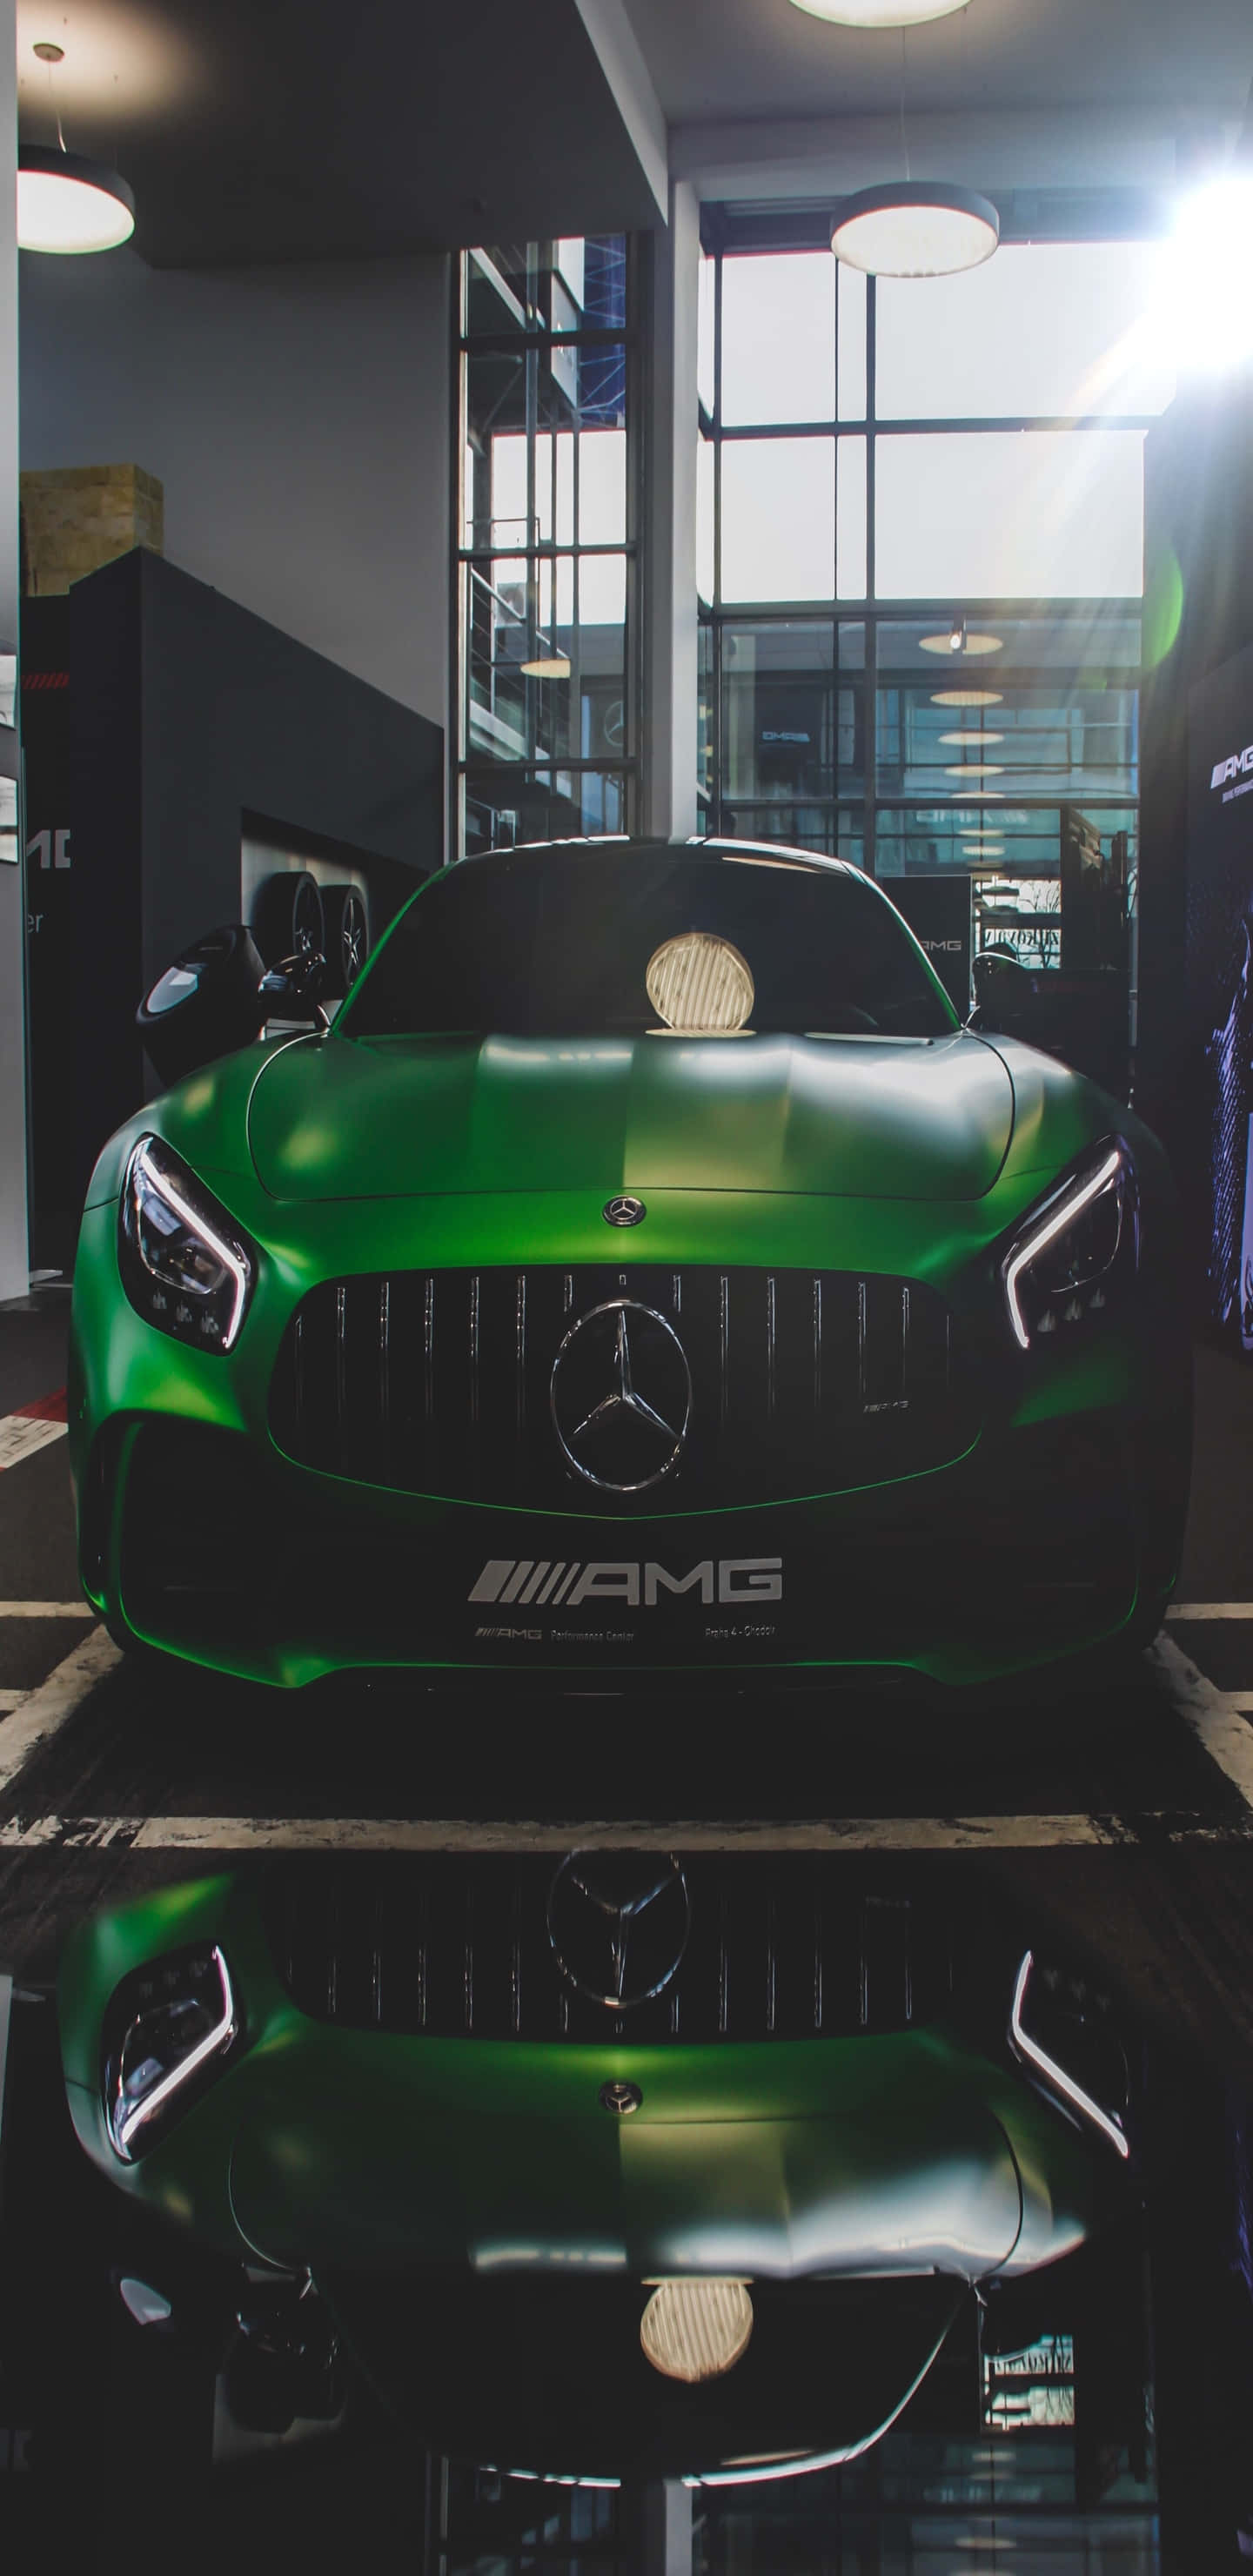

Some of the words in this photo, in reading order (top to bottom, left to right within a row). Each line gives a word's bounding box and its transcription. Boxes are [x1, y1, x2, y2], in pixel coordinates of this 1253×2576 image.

[920, 940, 962, 951] AMG
[566, 1557, 783, 1607] AMG
[496, 1628, 543, 1640] AMG
